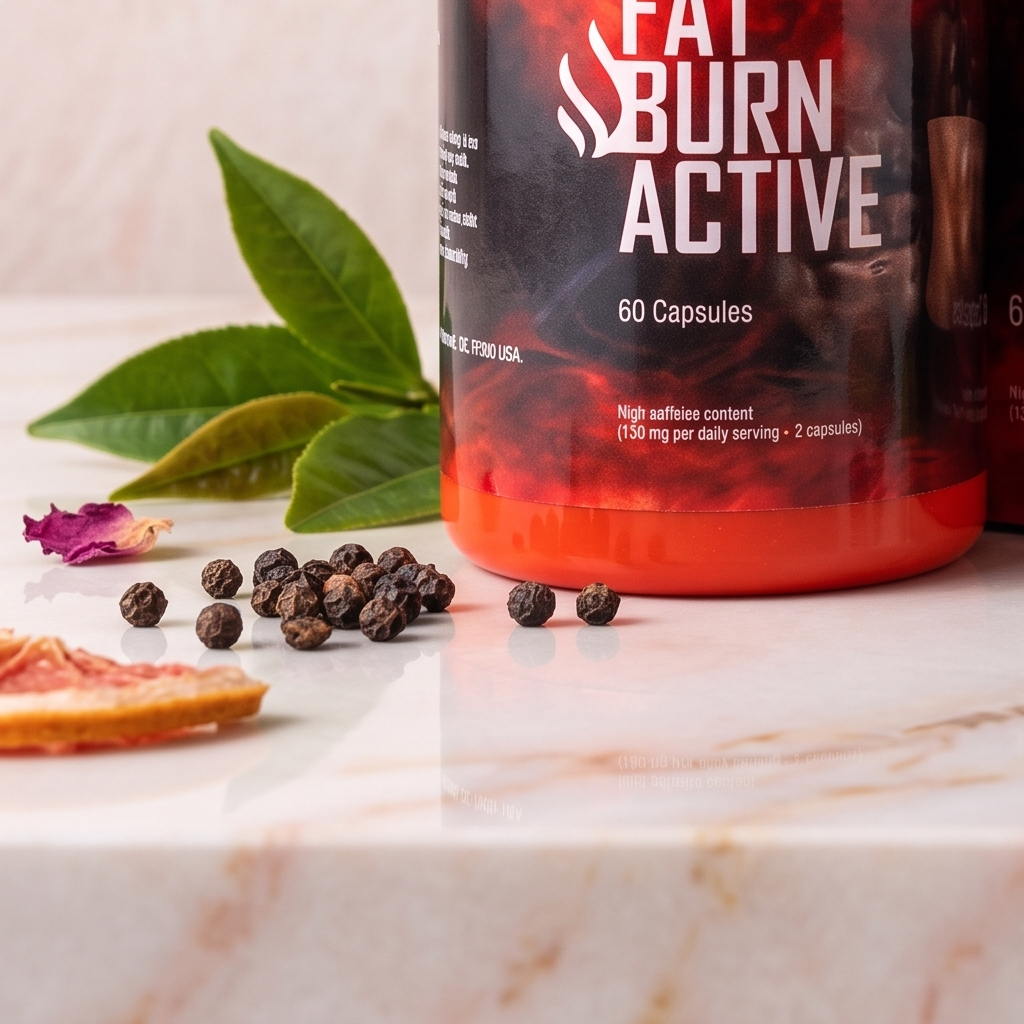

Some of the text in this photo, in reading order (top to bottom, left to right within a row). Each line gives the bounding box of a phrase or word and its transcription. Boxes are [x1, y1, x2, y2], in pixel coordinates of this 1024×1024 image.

[605, 59, 832, 155] BURN
[619, 154, 882, 254] ACTIVE
[618, 298, 753, 328] 60 Capsules
[498, 344, 524, 364] USA.
[704, 406, 753, 421] content
[650, 428, 669, 443] mg
[673, 428, 694, 443] per
[698, 426, 728, 444] daily
[733, 426, 780, 443] serving
[794, 424, 803, 438] 2
[806, 419, 862, 440] capsules)
